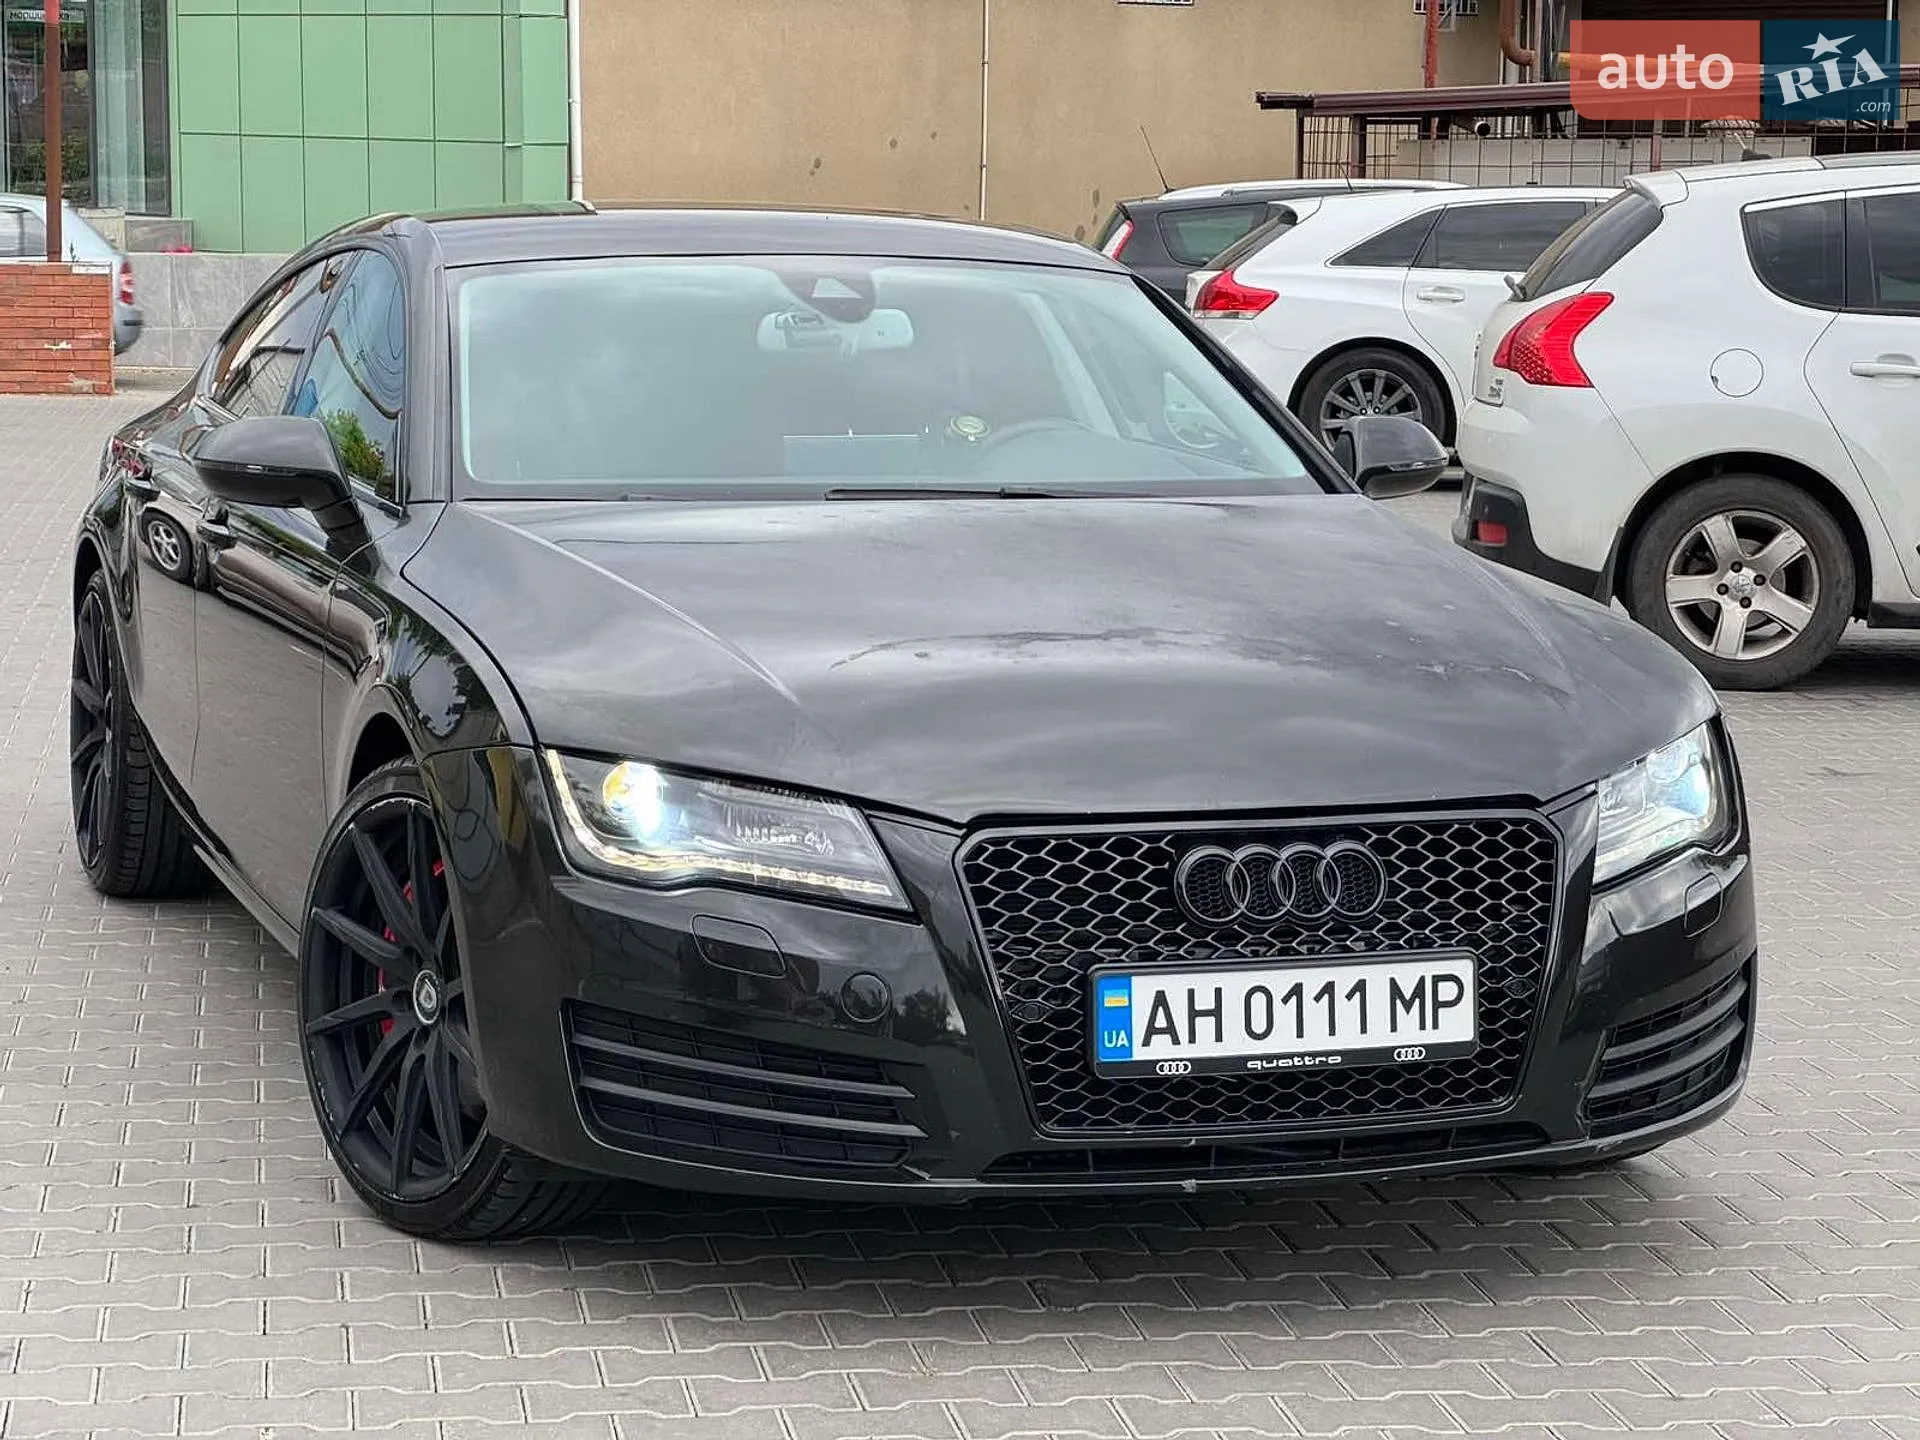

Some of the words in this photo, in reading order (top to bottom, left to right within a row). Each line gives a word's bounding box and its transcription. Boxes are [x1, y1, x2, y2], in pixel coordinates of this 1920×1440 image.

[1141, 986, 1223, 1048] AH
[1243, 978, 1368, 1041] 0111
[1389, 973, 1465, 1033] MP
[1104, 1031, 1129, 1048] UA
[1246, 1055, 1342, 1070] quattro
